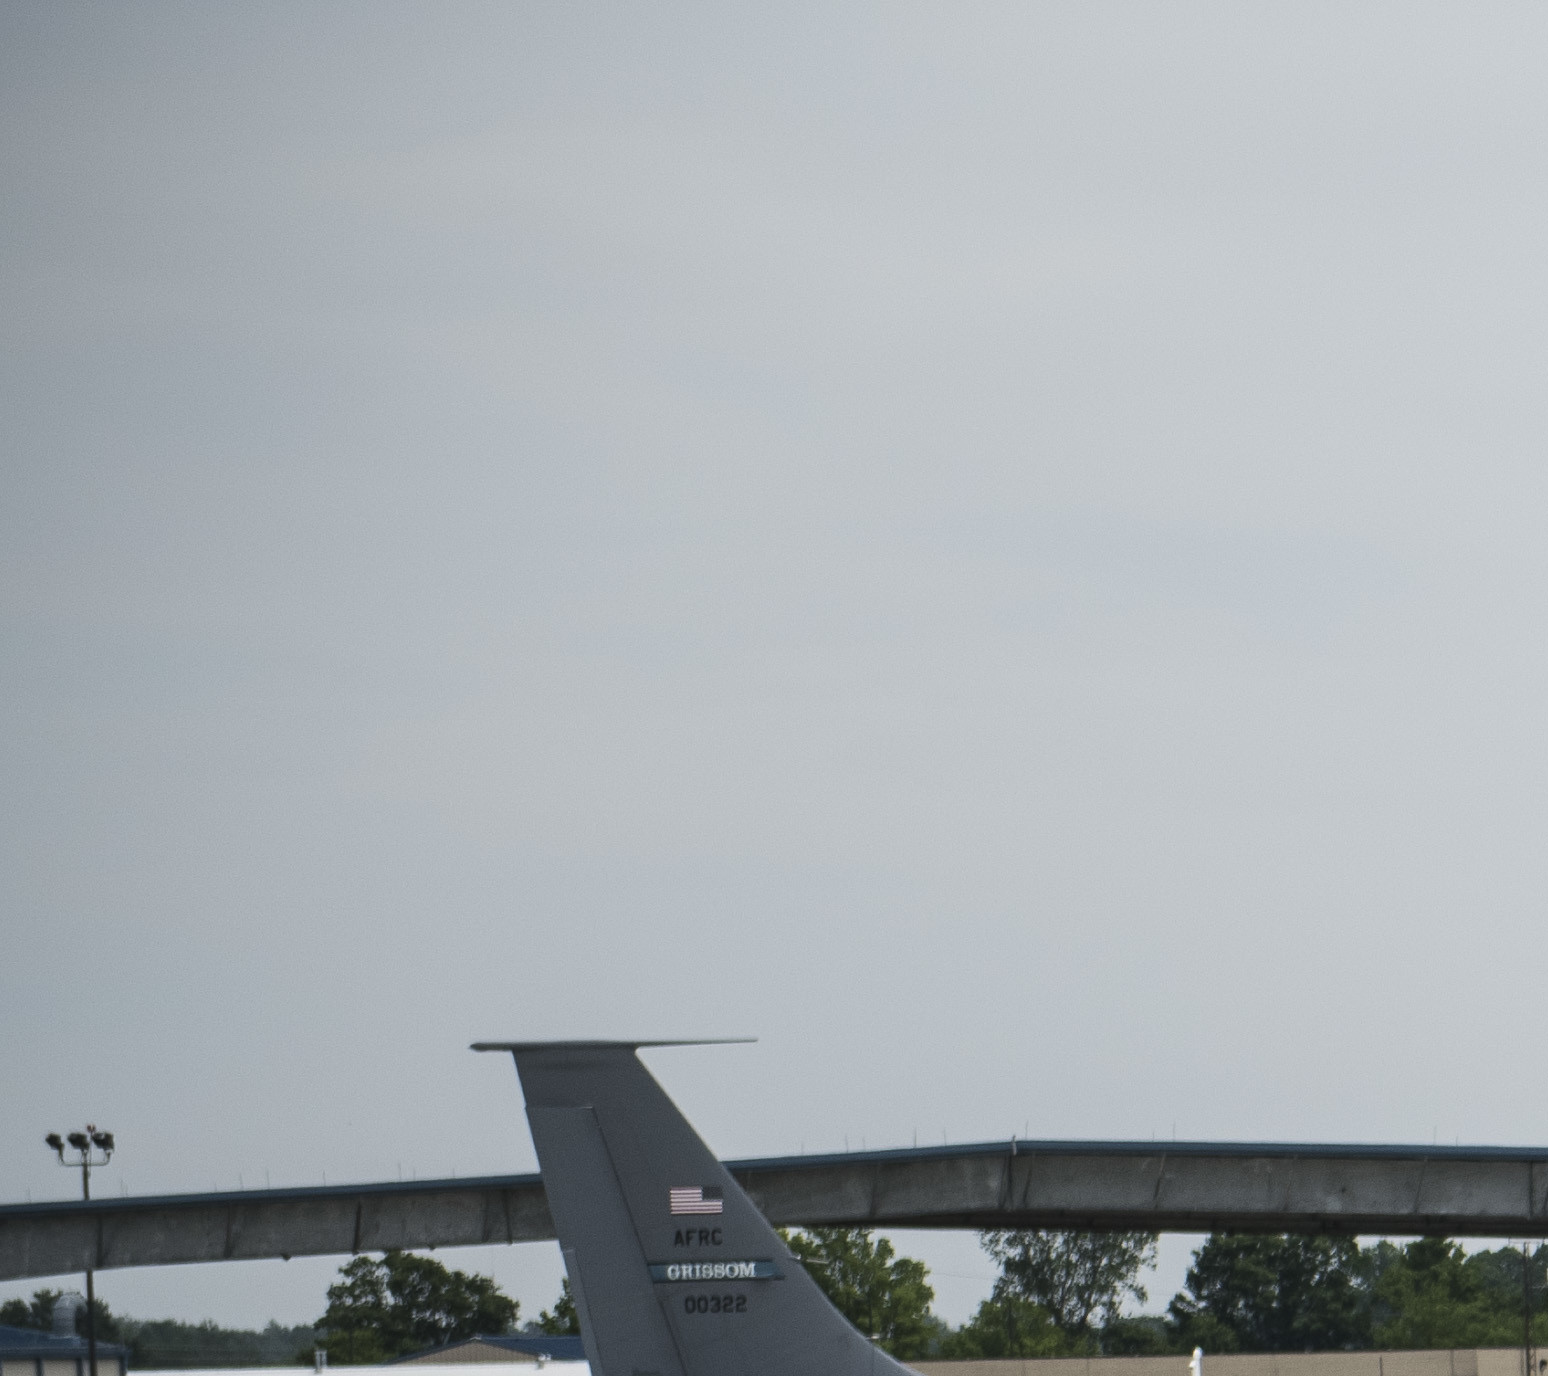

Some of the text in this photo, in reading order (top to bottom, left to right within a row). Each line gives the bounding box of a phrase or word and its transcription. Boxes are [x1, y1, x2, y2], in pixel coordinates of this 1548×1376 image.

[674, 1231, 723, 1248] AFRC
[667, 1262, 757, 1281] GRISSOM
[684, 1295, 748, 1313] 00322
